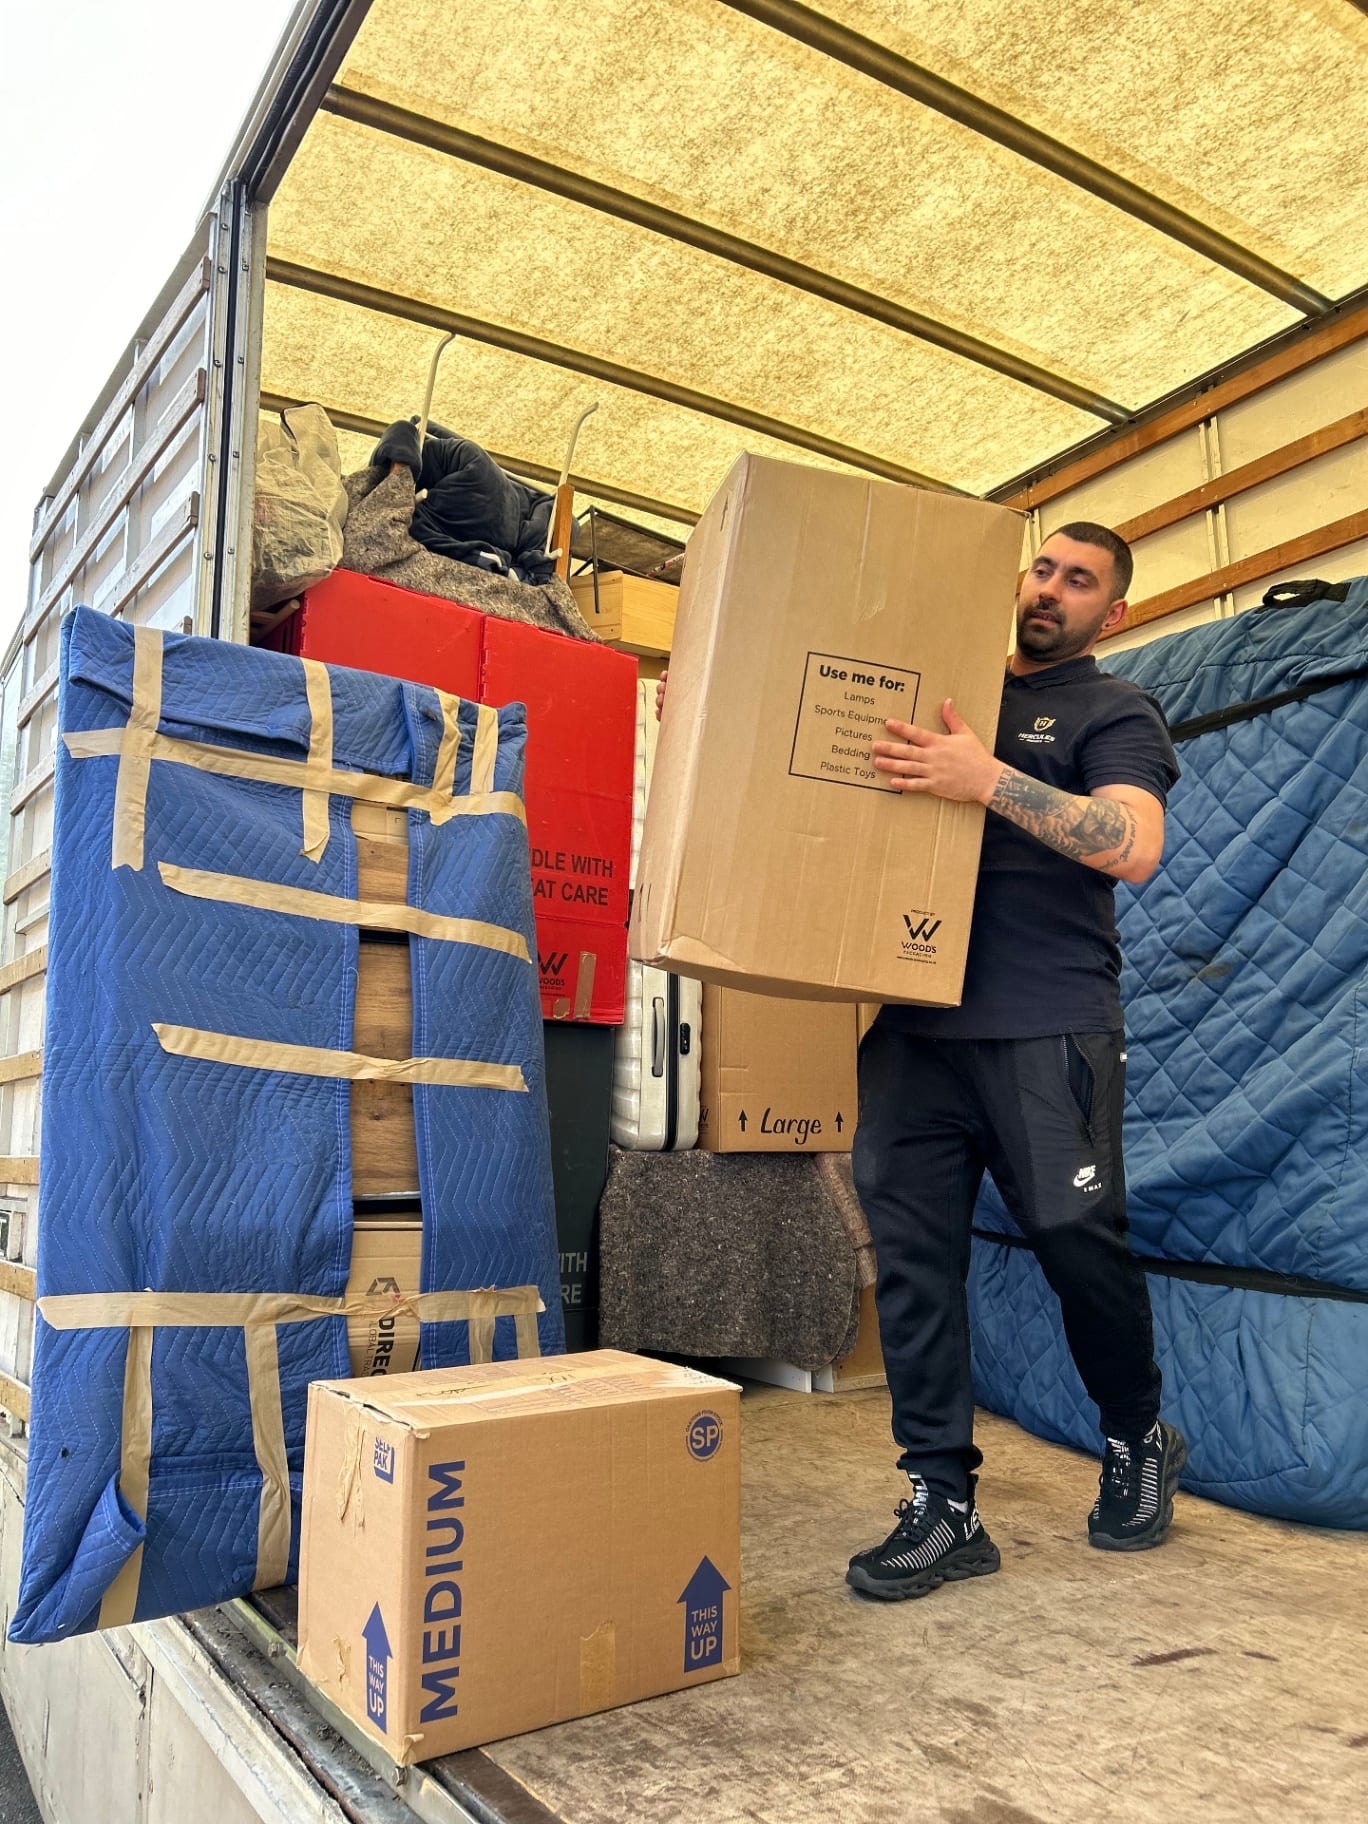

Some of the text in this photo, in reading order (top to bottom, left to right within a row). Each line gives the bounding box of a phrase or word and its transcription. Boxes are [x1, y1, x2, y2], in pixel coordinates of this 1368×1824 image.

[819, 664, 905, 692] Use me for:
[844, 692, 876, 705] Lamps
[814, 704, 845, 718] Sports
[835, 726, 873, 742] Pictures
[831, 744, 871, 761] Bedding
[820, 761, 876, 780] Plastic Toys
[529, 848, 613, 878] DLE WITH
[561, 882, 609, 906] CARE
[901, 941, 937, 954] WOODS
[760, 1107, 822, 1145] Large
[558, 1251, 588, 1273] ITH
[692, 1425, 719, 1449] SP
[420, 1460, 466, 1724] MEDIUM
[691, 1605, 718, 1622] THIS
[691, 1620, 718, 1638] WAY
[691, 1636, 718, 1660] UP
[368, 1655, 384, 1678] THIS
[368, 1671, 384, 1695] WAY
[369, 1688, 384, 1718] UP
